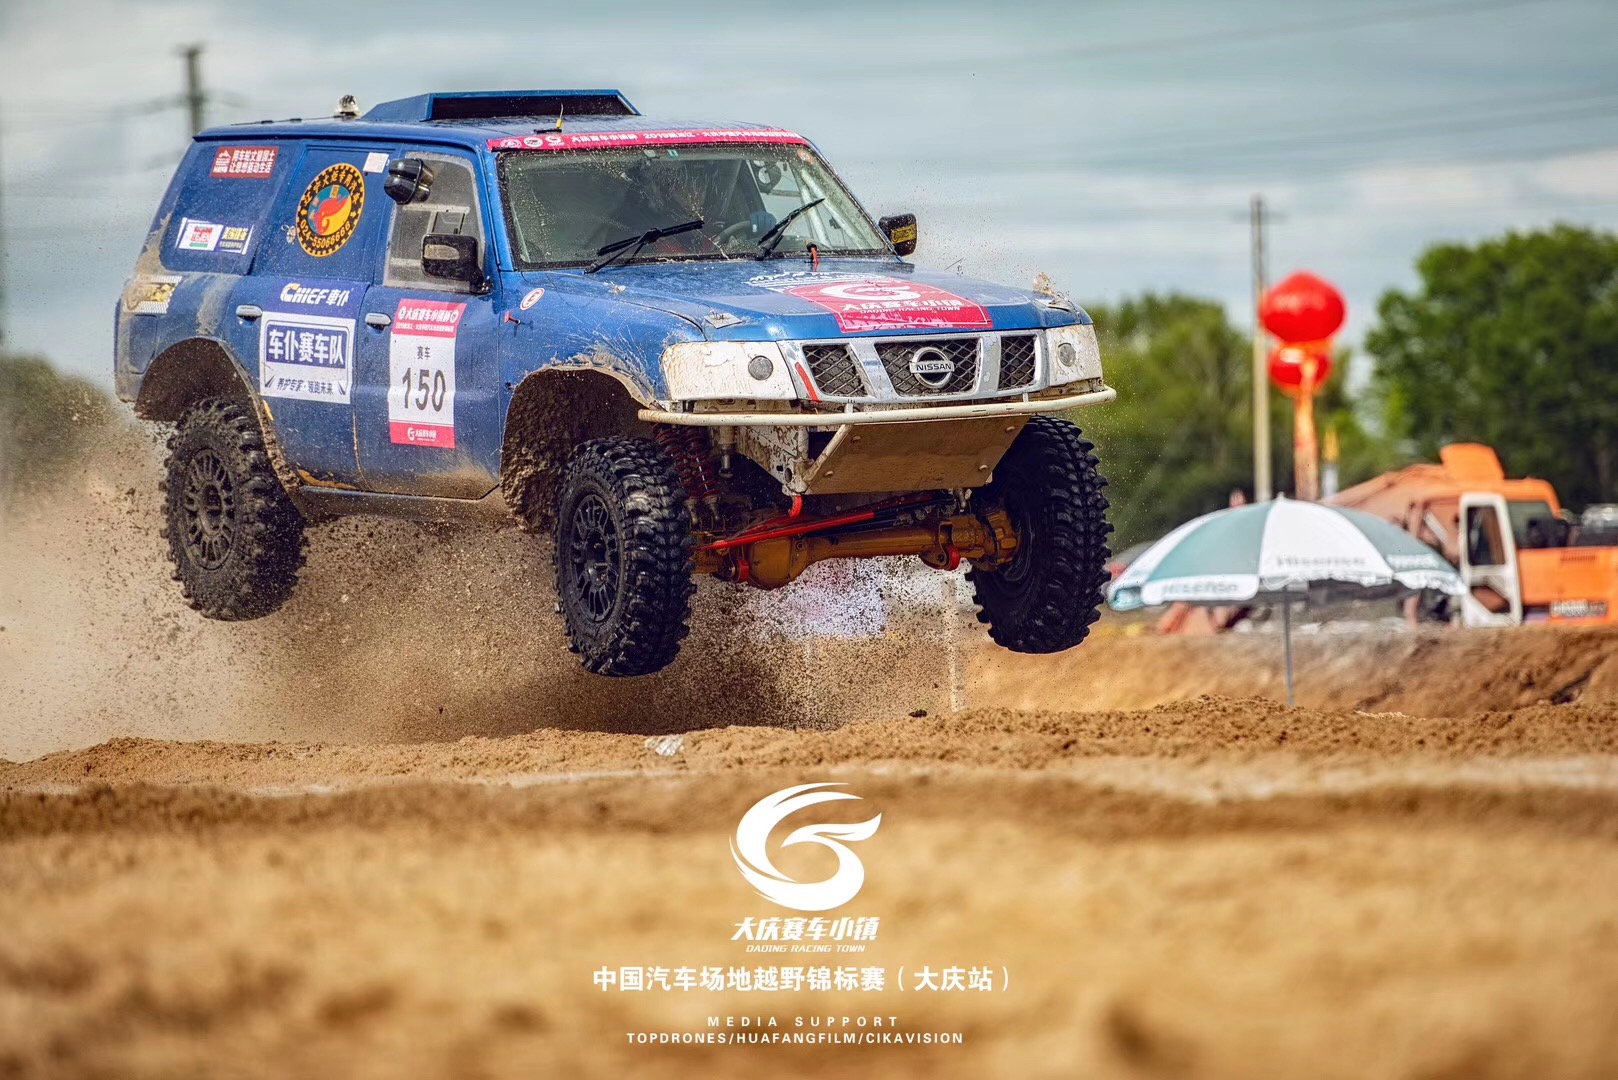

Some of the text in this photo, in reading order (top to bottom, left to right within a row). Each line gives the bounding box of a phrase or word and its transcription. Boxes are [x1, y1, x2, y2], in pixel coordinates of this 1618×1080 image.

[280, 283, 330, 304] CHIEF
[268, 329, 344, 366] 车仆赛车队
[417, 345, 431, 360] 赛车
[916, 363, 951, 371] NISSAN
[402, 367, 447, 412] 150
